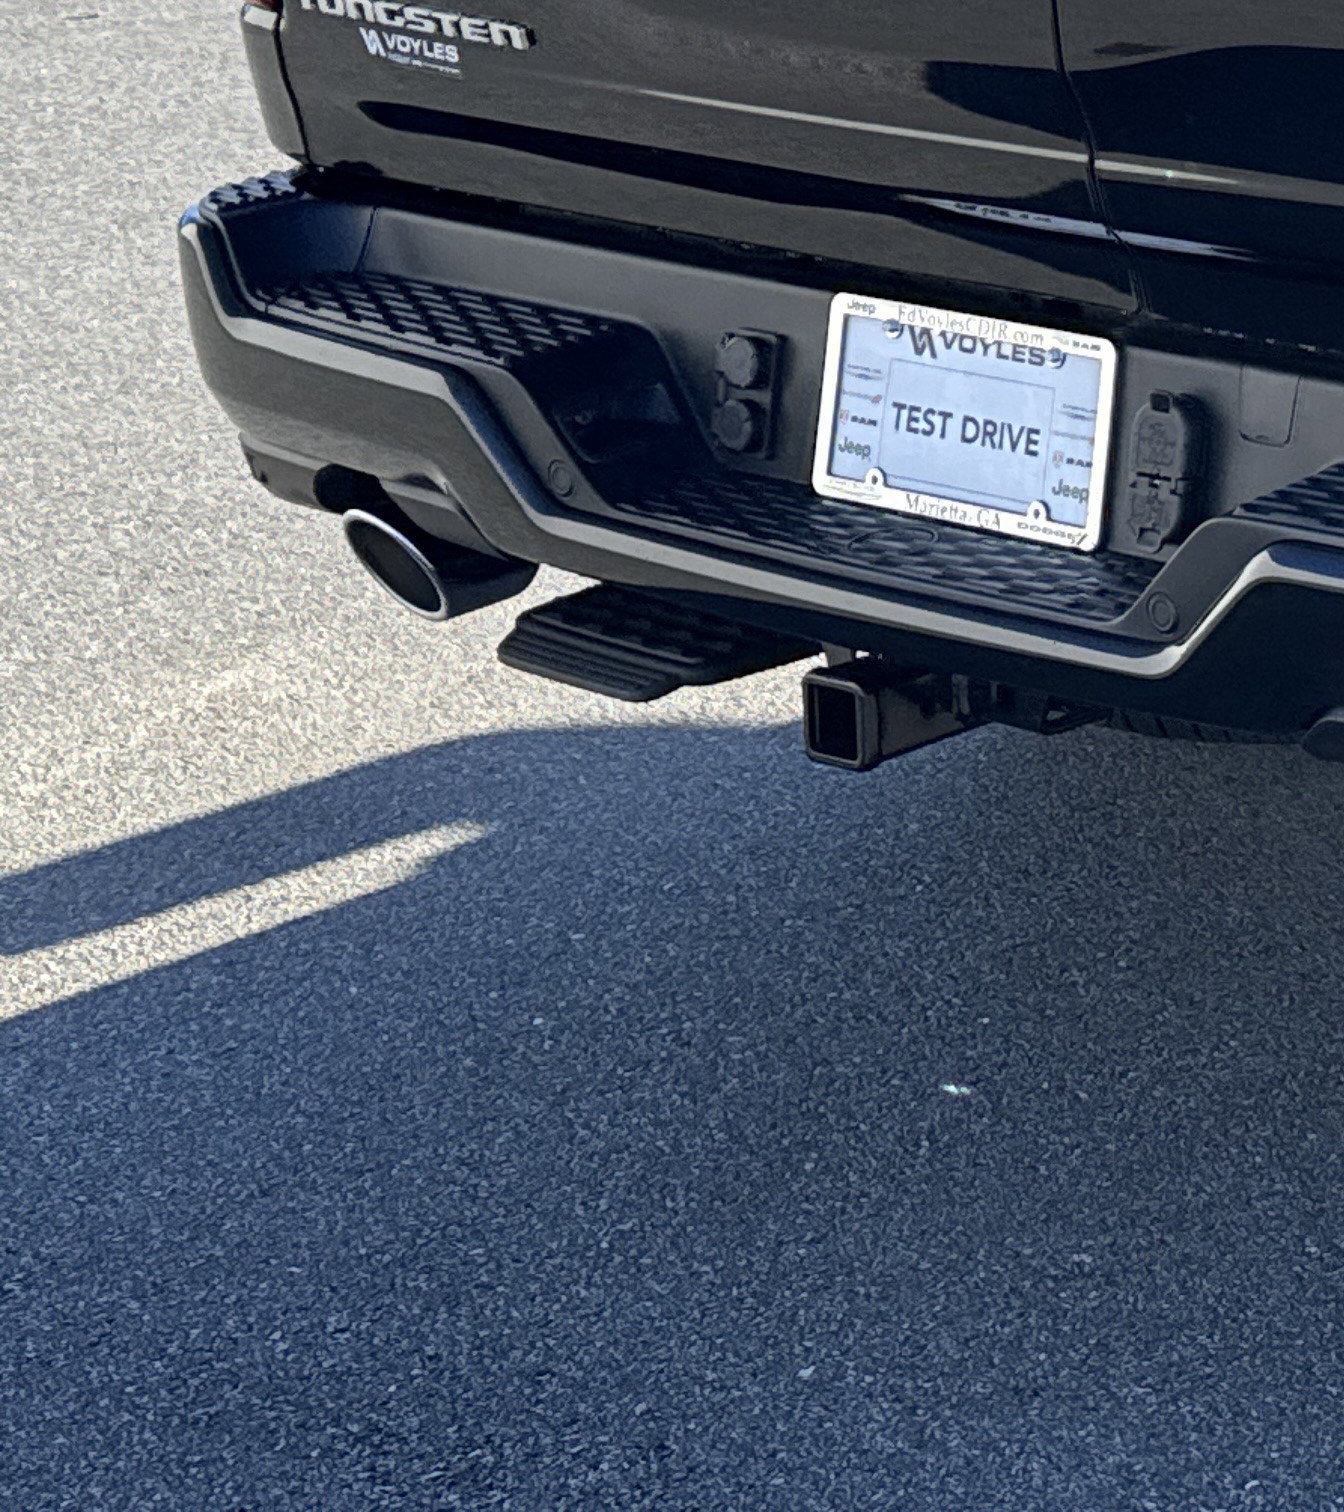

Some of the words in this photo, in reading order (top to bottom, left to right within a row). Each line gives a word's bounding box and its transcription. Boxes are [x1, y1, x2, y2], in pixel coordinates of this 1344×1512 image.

[381, 30, 460, 63] VOYLES
[939, 329, 1046, 368] VOYLES
[891, 401, 953, 439] TEST
[960, 415, 1041, 457] DRIVE
[838, 437, 871, 459] Jeep
[1052, 479, 1089, 502] Jeep
[976, 507, 1001, 529] GA
